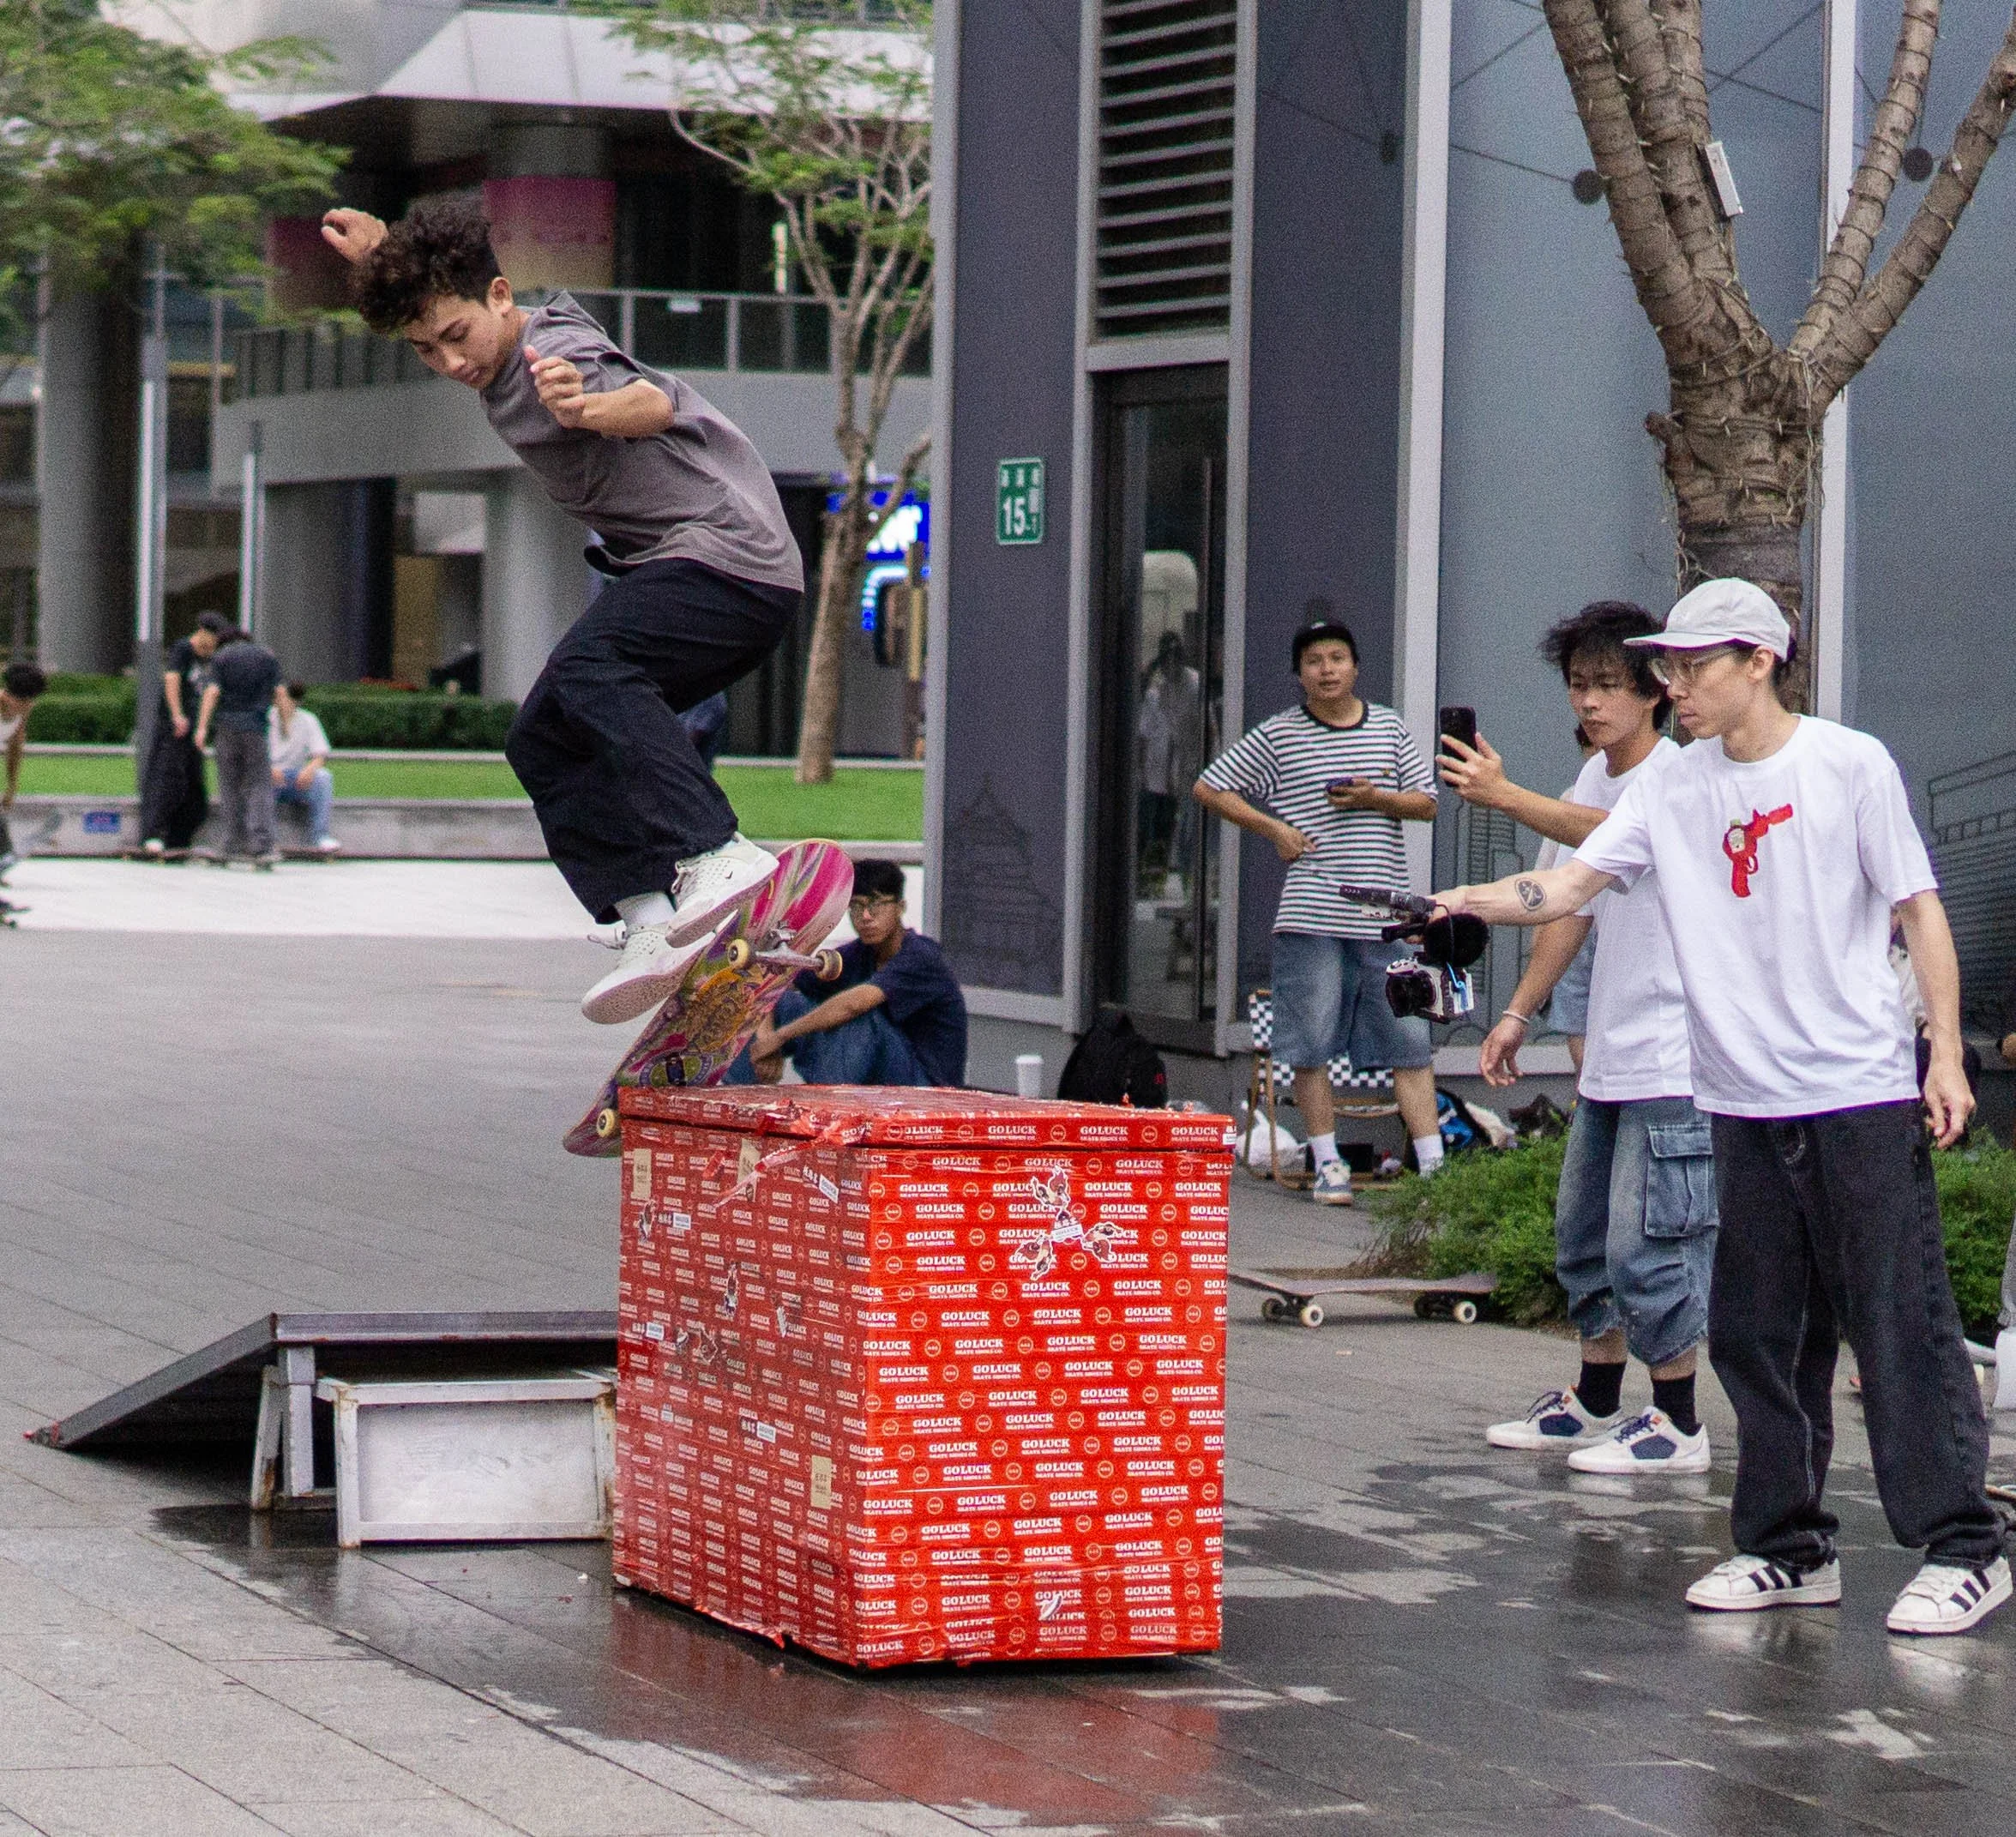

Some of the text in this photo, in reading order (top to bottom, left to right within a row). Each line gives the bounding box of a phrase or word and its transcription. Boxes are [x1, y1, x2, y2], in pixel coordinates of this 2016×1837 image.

[988, 1126, 1036, 1135] GOLUCK
[1080, 1126, 1128, 1135] GOLUCK
[1171, 1127, 1217, 1136] GOLUCK
[933, 1157, 980, 1166] GOLUCK
[1116, 1159, 1163, 1169] GOLUCK
[900, 1184, 948, 1193] GOLUCK
[1085, 1182, 1132, 1191] GOLUCK
[1175, 1183, 1221, 1192] GOLUCK
[916, 1204, 965, 1213] GOLUCK
[1100, 1204, 1147, 1214] GOLUCK
[906, 1231, 955, 1240] GOLUCK
[1181, 1232, 1226, 1241] GOLUCK
[917, 1256, 966, 1265] GOLUCK
[929, 1284, 978, 1293] GOLUCK
[1021, 1282, 1070, 1292] GOLUCK
[1114, 1280, 1162, 1290] GOLUCK
[858, 1310, 897, 1321] GOLUCK
[941, 1311, 990, 1322] GOLUCK
[1033, 1309, 1081, 1319] GOLUCK
[1125, 1307, 1172, 1316] GOLUCK
[954, 1339, 1003, 1349] GOLUCK
[1047, 1335, 1095, 1346] GOLUCK
[1140, 1334, 1187, 1344] GOLUCK
[864, 1340, 911, 1351] GOLUCK
[973, 1364, 1021, 1374] GOLUCK
[1064, 1361, 1113, 1371] GOLUCK
[1157, 1359, 1203, 1369] GOLUCK
[880, 1366, 929, 1376] GOLUCK
[988, 1391, 1037, 1401] GOLUCK
[1080, 1388, 1128, 1398] GOLUCK
[1172, 1386, 1218, 1396] GOLUCK
[896, 1394, 944, 1404] GOLUCK
[1006, 1413, 1054, 1424] GOLUCK
[1098, 1411, 1146, 1421] GOLUCK
[912, 1418, 961, 1428] GOLUCK
[1022, 1438, 1070, 1449] GOLUCK
[1114, 1436, 1161, 1447] GOLUCK
[929, 1442, 978, 1452] GOLUCK
[943, 1464, 991, 1475] GOLUCK
[1035, 1462, 1084, 1473] GOLUCK
[1127, 1461, 1175, 1471] GOLUCK
[857, 1469, 899, 1480] GOLUCK
[1050, 1491, 1098, 1501] GOLUCK
[1141, 1485, 1189, 1497] GOLUCK
[864, 1499, 912, 1509] GOLUCK
[957, 1495, 1006, 1506] GOLUCK
[1104, 1512, 1152, 1523] GOLUCK
[922, 1523, 970, 1534] GOLUCK
[1014, 1518, 1062, 1529] GOLUCK
[1025, 1545, 1072, 1556] GOLUCK
[1116, 1540, 1163, 1551] GOLUCK
[932, 1550, 980, 1560] GOLUCK
[1124, 1564, 1170, 1575] GOLUCK
[1125, 1586, 1171, 1596] GOLUCK
[942, 1594, 990, 1605] GOLUCK
[1128, 1607, 1176, 1617] GOLUCK
[1040, 1626, 1086, 1635] GOLUCK
[1130, 1625, 1177, 1635] GOLUCK
[949, 1630, 995, 1642] GOLUCK
[858, 1641, 904, 1652] GOLUCK
